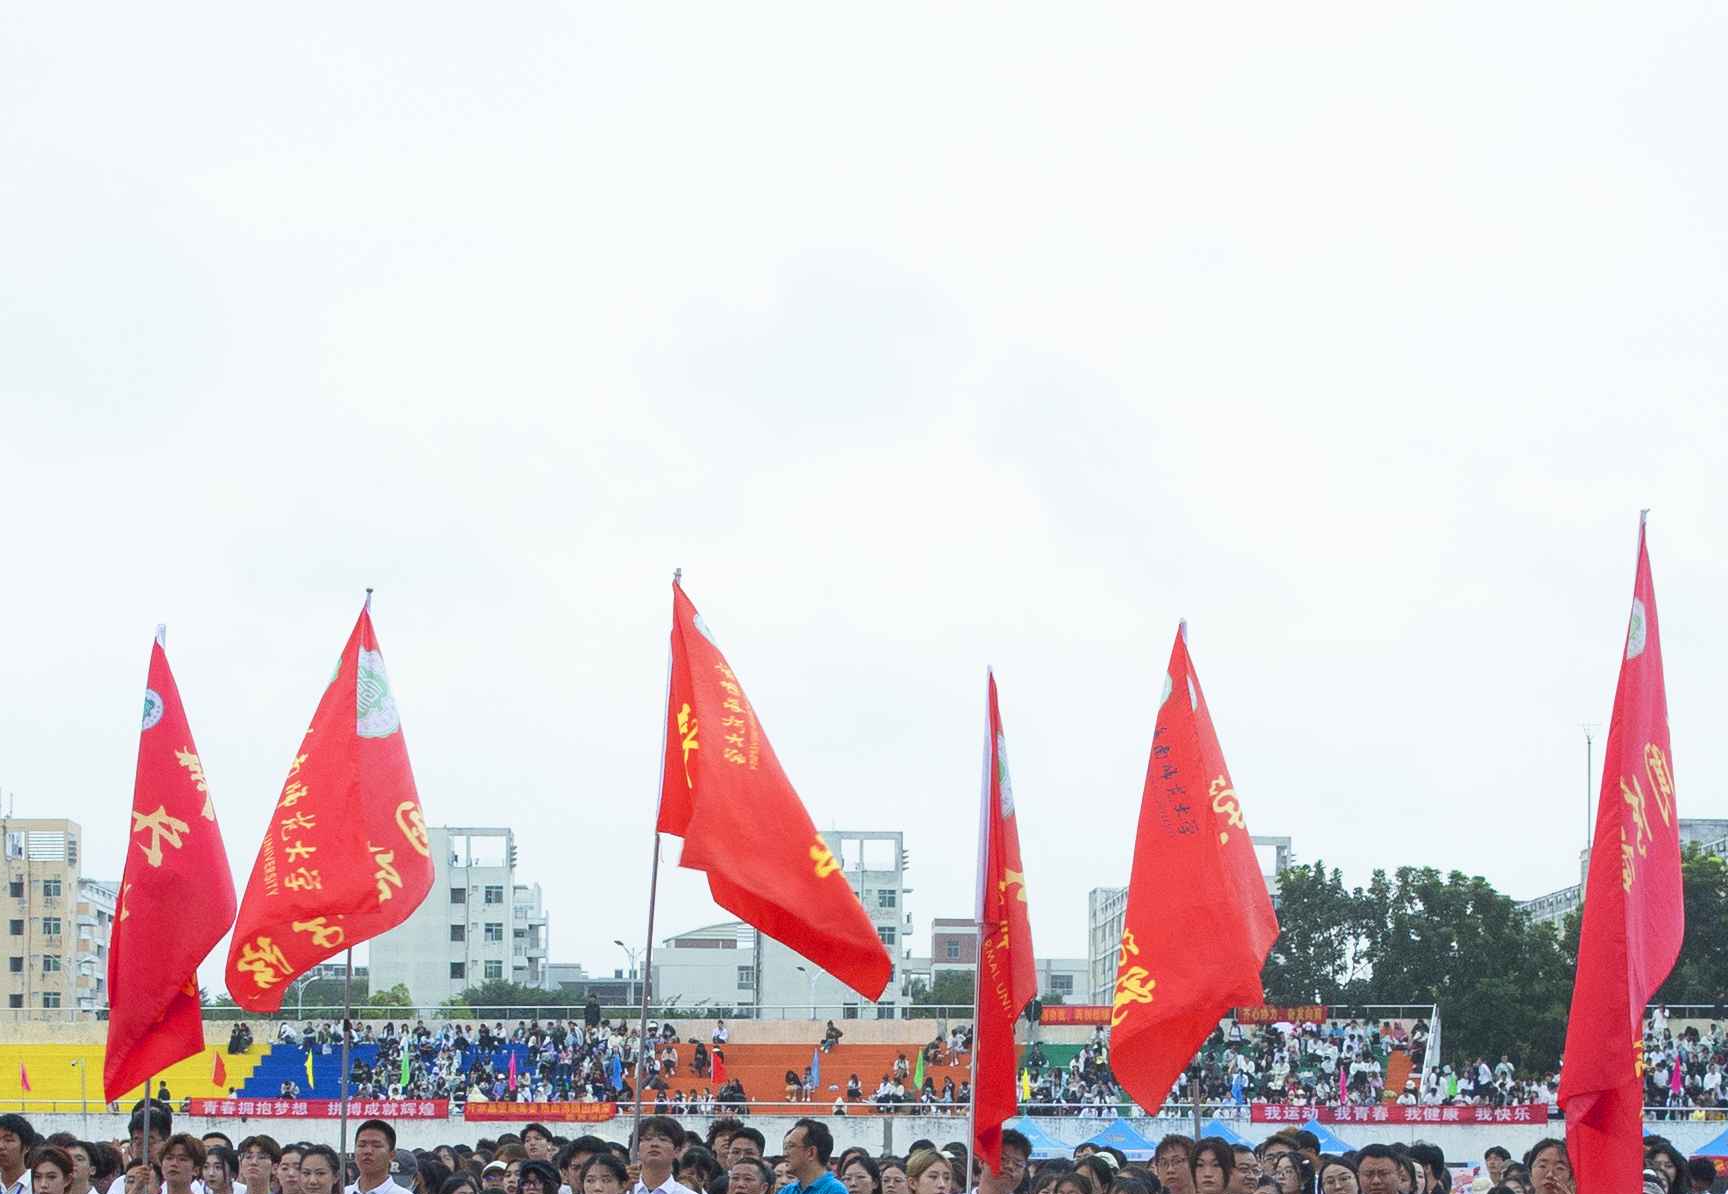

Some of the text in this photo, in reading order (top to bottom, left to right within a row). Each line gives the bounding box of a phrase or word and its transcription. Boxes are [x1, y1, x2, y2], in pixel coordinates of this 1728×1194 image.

[202, 1101, 309, 1117] 青春拥抱梦想
[1265, 1106, 1531, 1121] 我运动 我青春 我健康 我快乐
